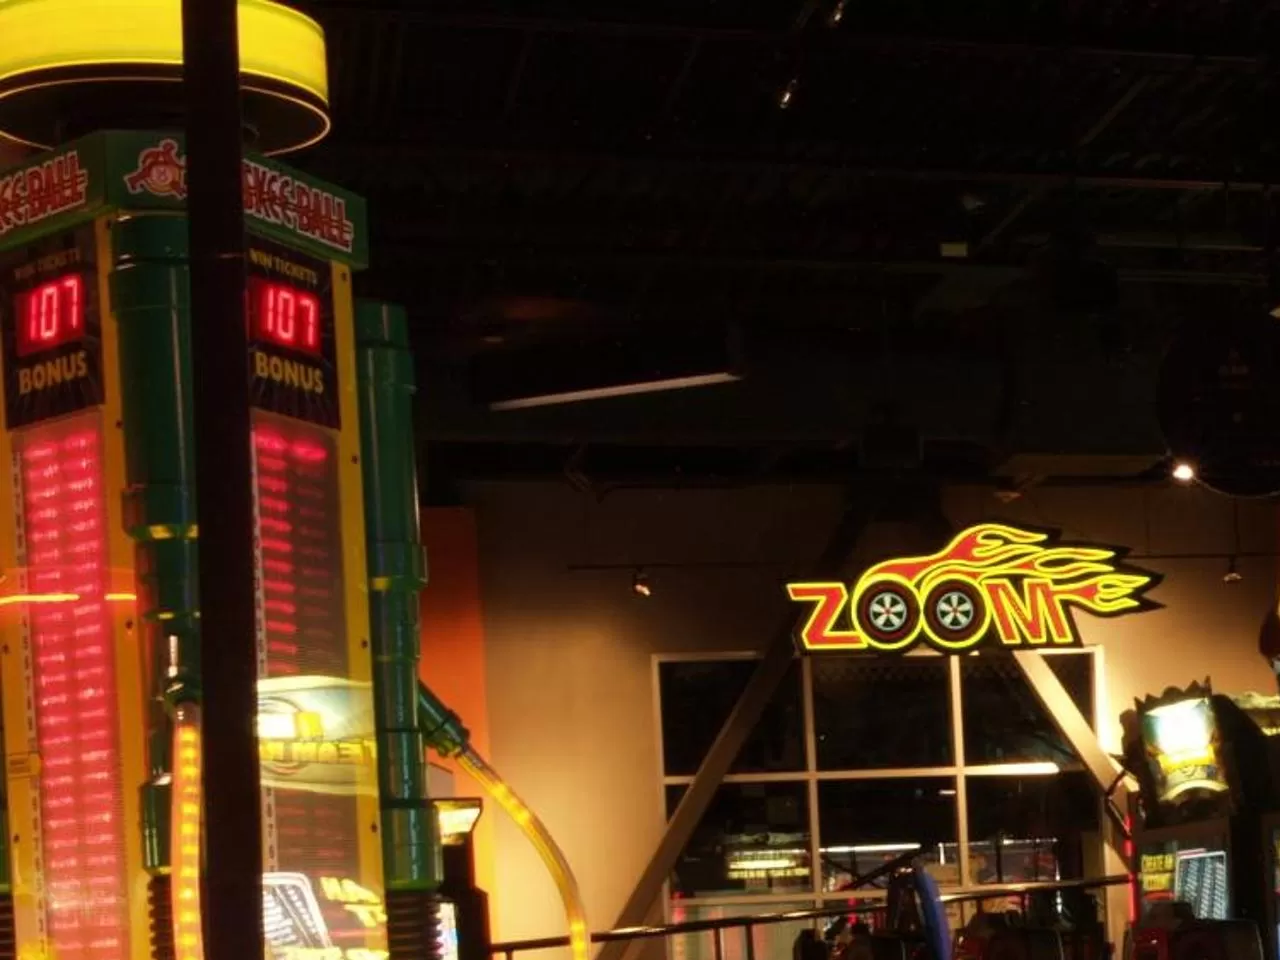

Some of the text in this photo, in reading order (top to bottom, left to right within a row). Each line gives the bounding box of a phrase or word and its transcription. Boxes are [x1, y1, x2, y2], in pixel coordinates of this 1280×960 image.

[29, 277, 80, 342] 107
[265, 286, 316, 346] 107
[19, 351, 88, 395] BONUS
[254, 351, 325, 395] BONUS
[787, 572, 1074, 650] ZOOM
